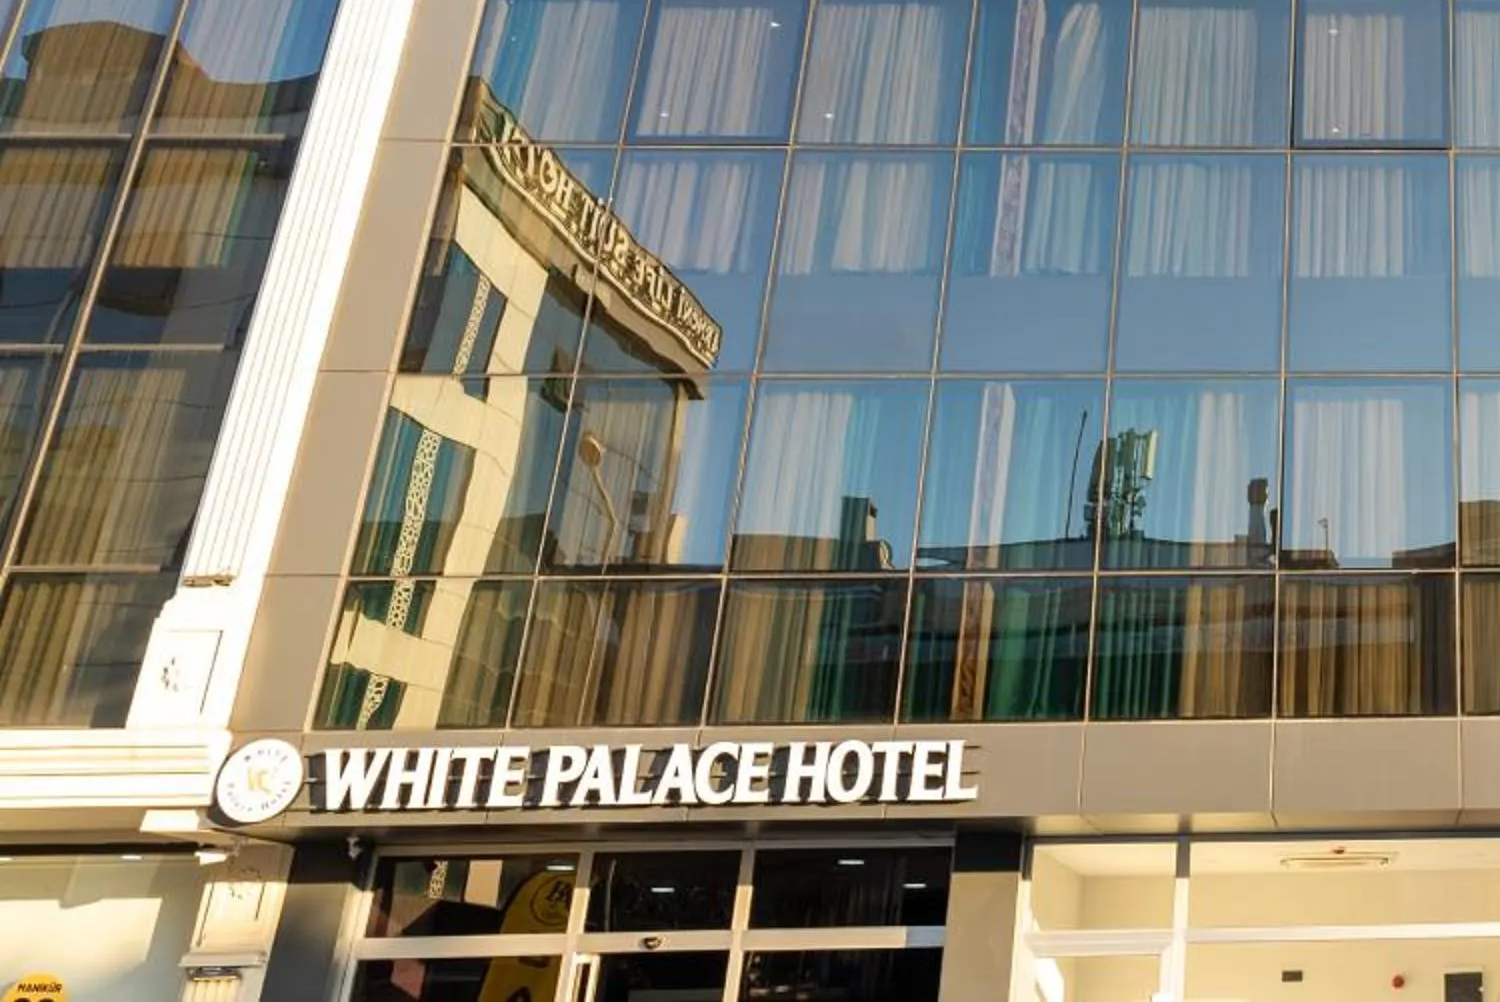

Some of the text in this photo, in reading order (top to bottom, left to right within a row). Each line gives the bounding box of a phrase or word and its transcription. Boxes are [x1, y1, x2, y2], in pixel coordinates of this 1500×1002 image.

[324, 746, 531, 809] WHITE
[541, 741, 774, 806] PALACE
[783, 739, 978, 802] HOTEL
